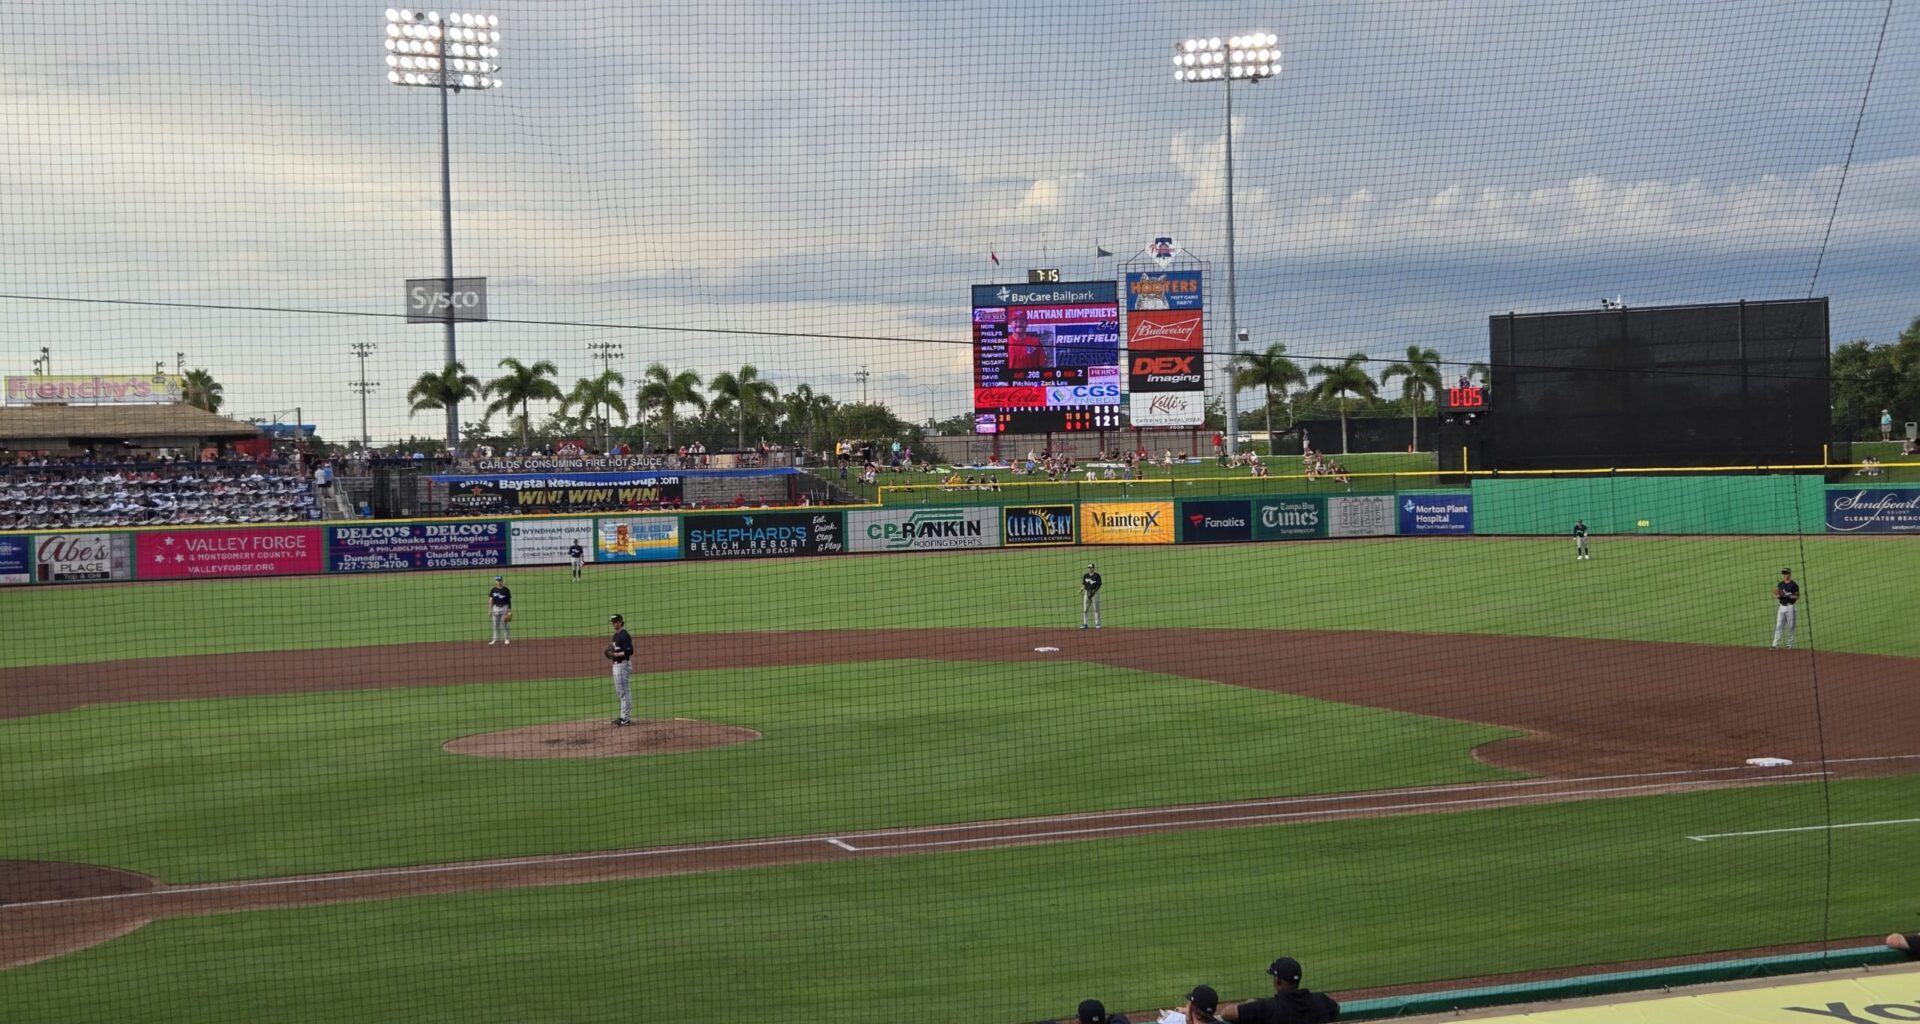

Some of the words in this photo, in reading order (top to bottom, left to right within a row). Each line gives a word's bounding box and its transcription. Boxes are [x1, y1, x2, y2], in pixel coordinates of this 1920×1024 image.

[1036, 270, 1059, 281] 7:15
[1131, 280, 1198, 295] HOOTERS
[411, 286, 479, 314] Sysco
[1011, 291, 1051, 304] BayCare
[1053, 290, 1095, 303] Ballpark
[1027, 309, 1064, 320] NATHAN
[1065, 308, 1117, 319] HUMPHREYS
[1097, 321, 1118, 330] 24
[1138, 325, 1194, 336] Budweiser
[1056, 333, 1118, 343] RIGHTFIELD
[1132, 356, 1195, 375] DEX
[1077, 369, 1083, 377] 2
[1147, 374, 1201, 383] imaging
[7, 376, 154, 401] Frenchy's
[1073, 384, 1120, 397] CGS
[1450, 387, 1483, 407] 0:05
[1149, 394, 1188, 414] Kelli's
[1095, 415, 1101, 427] 1
[1103, 415, 1110, 427] 2
[1113, 415, 1119, 426] 1
[479, 461, 521, 470] CARLOS
[524, 459, 583, 469] CONSUMING
[585, 458, 606, 467] FIRE
[608, 457, 627, 467] HOT
[630, 457, 663, 466] SAUCE
[518, 490, 564, 504] WIN!
[568, 488, 613, 502] WIN!
[618, 487, 660, 501] WIN!
[1280, 502, 1301, 511] Tampa
[1302, 502, 1315, 510] Bay
[1416, 505, 1445, 513] Morton
[1446, 504, 1468, 513] Plant
[1261, 505, 1319, 528] Times
[1416, 514, 1450, 524] Hospital
[1007, 515, 1044, 536] CLEAR
[1049, 513, 1072, 535] SKY
[1092, 511, 1161, 534] MaintenX
[1205, 517, 1245, 528] Fanatics
[337, 526, 411, 539] DELCO'S
[425, 523, 498, 536] DELCO'S
[564, 526, 592, 534] GRAND
[691, 527, 807, 543] SHEPHARD'S
[185, 537, 248, 551] VALLEY
[253, 535, 306, 549] FORGE
[347, 537, 388, 547] Original
[391, 536, 425, 544] Steaks
[428, 536, 447, 544] and
[450, 535, 490, 544] Hoagies
[816, 533, 833, 543] Stay
[914, 539, 948, 548] ROOFING
[950, 538, 982, 547] EXPERTS
[37, 535, 110, 562] Abe's
[376, 544, 429, 552] PHILADELPHIA
[691, 541, 739, 550] BEACH
[751, 539, 807, 549] RESORT
[825, 542, 841, 552] Play
[197, 552, 255, 561] MONTGOMERY
[295, 550, 307, 558] PA
[344, 554, 386, 562] Dunedin,
[388, 553, 400, 561] FL
[425, 551, 459, 559] Chadds
[461, 550, 484, 558] Ford,
[704, 548, 763, 556] CLEARWATER
[60, 562, 104, 572] PLACE
[188, 563, 274, 573] VALLEYFORGE.ORG
[337, 560, 409, 570] 727-738-4700
[427, 557, 498, 567] 610-558-8289
